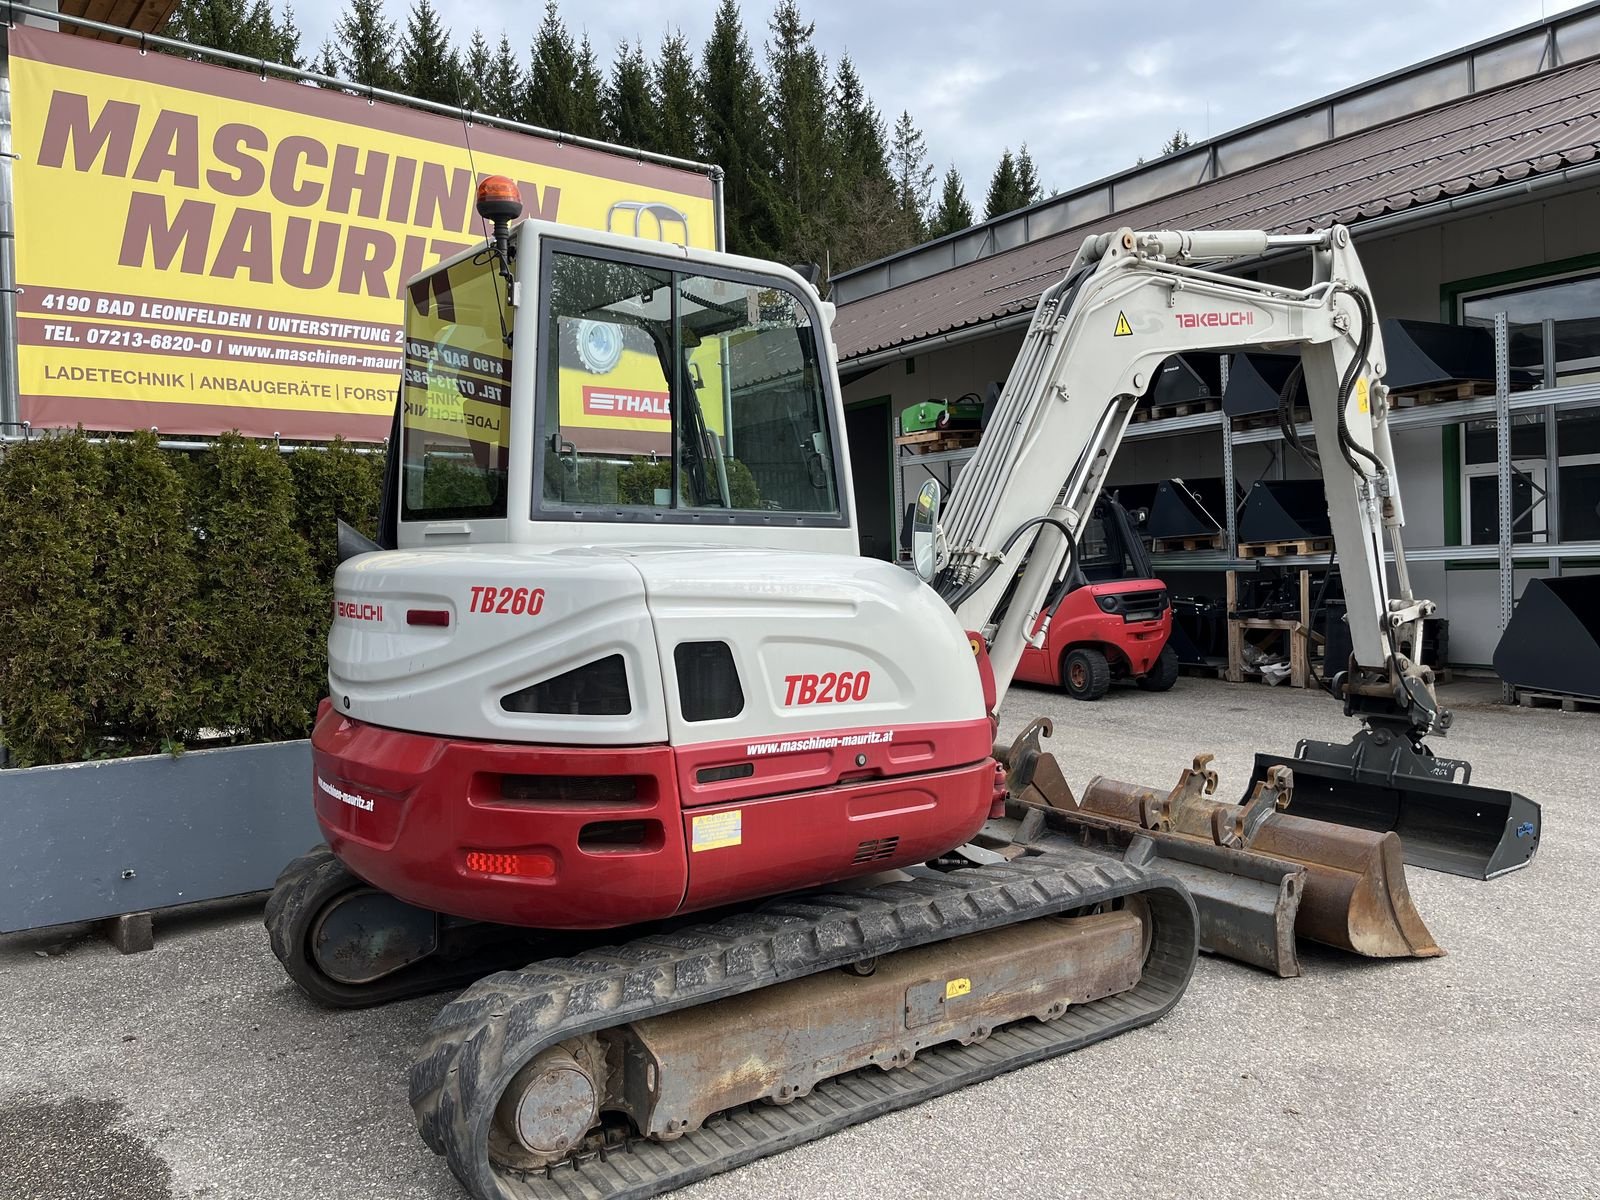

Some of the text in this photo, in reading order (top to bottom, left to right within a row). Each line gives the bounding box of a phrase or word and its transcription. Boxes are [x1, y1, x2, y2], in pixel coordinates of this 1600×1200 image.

[42, 294, 91, 312] 4190
[96, 298, 135, 316] BAD
[140, 302, 252, 329] LEONFELDEN
[268, 316, 391, 343] UNTERSTIFTUNG
[1175, 311, 1254, 329] TAKEUCHI
[44, 324, 403, 370] TEL. 07213-6820-0 www.maschinen-mauri
[45, 365, 400, 402] LADETECHNIK ANBAUGERÄTE FORST
[470, 586, 545, 616] TB260
[784, 670, 871, 706] TB260
[747, 730, 894, 755] www.maschinen-mauritz.at
